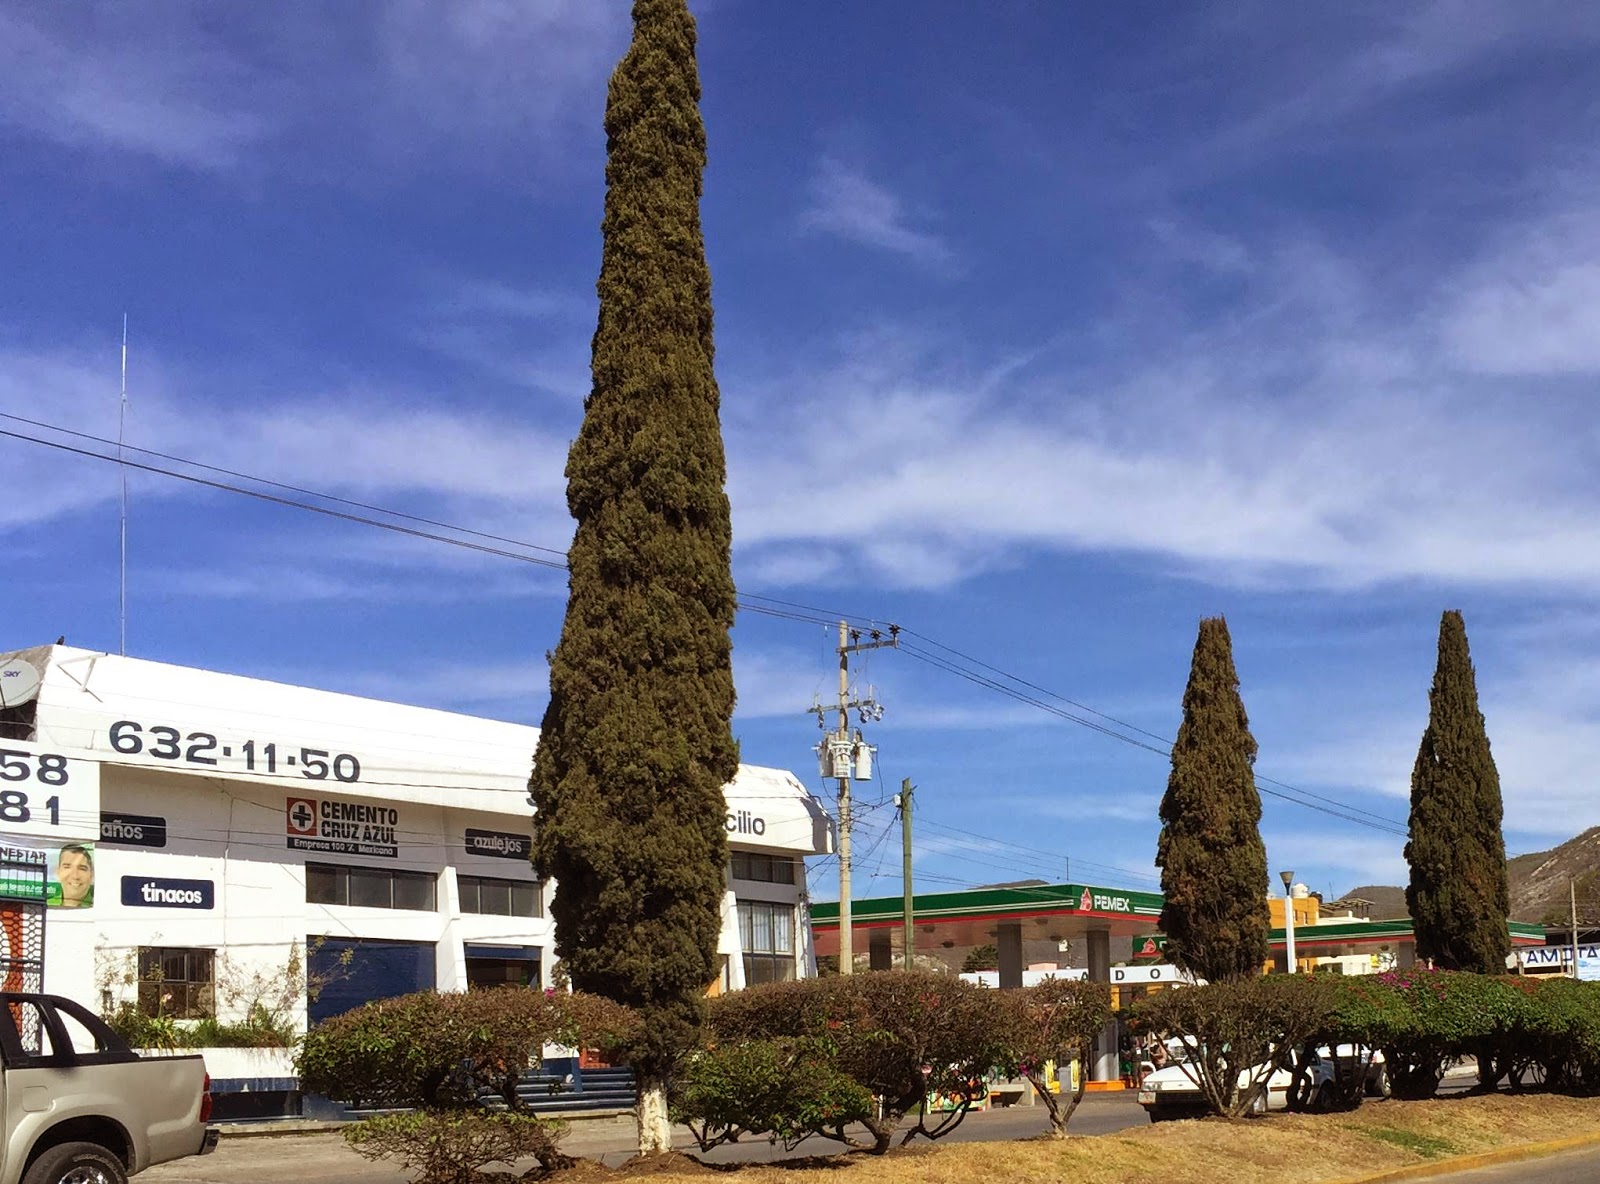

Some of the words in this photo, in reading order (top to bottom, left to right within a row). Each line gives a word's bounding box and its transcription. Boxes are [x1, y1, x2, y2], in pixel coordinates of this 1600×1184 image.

[3, 670, 21, 678] SKY
[0, 749, 69, 786] 58
[0, 790, 60, 826] 81
[321, 800, 399, 826] CEMENTO
[321, 820, 359, 840] CRUZ
[363, 824, 399, 845] AZUL
[294, 839, 330, 850] Empresa
[473, 836, 522, 855] azulejos
[141, 882, 203, 904] tinacos
[1094, 895, 1130, 911] PEMEX
